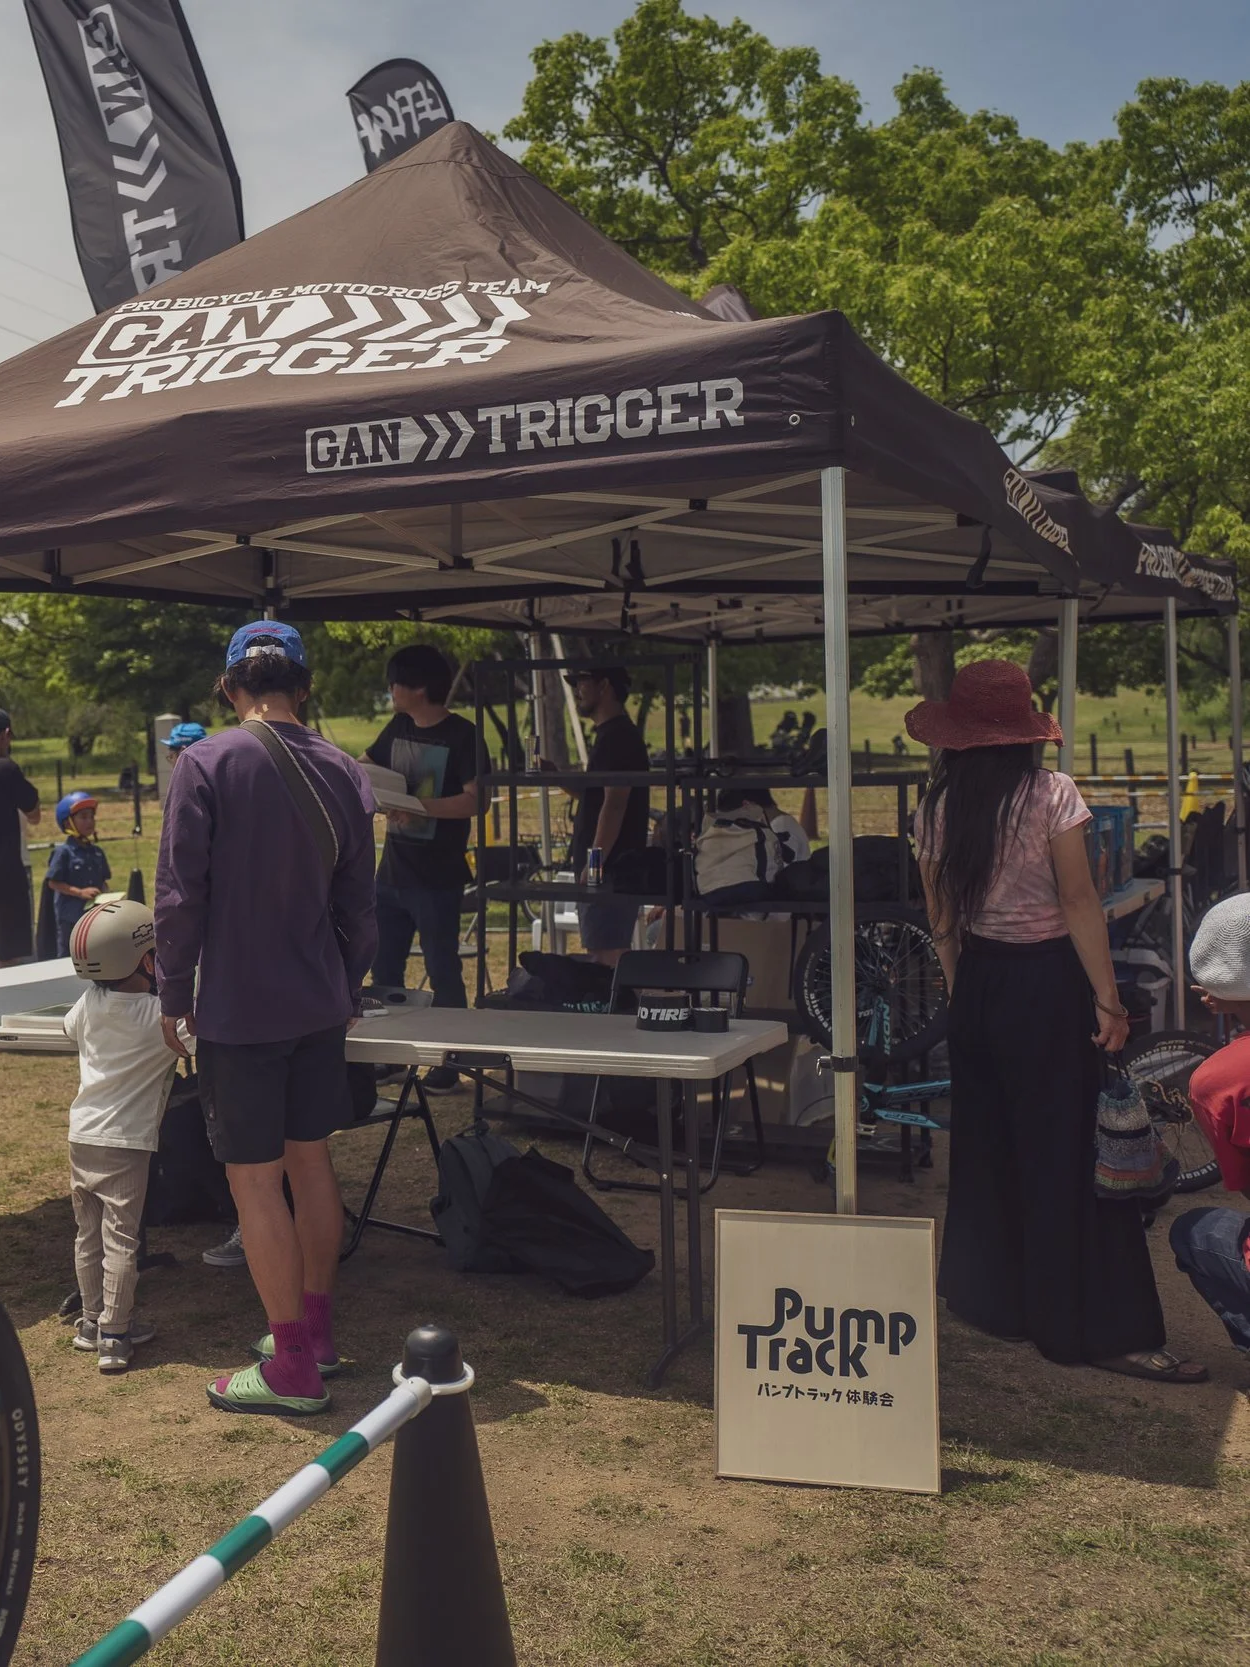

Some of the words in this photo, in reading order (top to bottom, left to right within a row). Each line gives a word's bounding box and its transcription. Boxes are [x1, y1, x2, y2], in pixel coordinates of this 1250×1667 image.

[116, 297, 174, 313] PRO
[174, 286, 288, 310] BICYCLE
[286, 280, 459, 300] MOTOCROSS
[467, 279, 552, 297] TEAM
[91, 300, 296, 360] GAN
[53, 338, 512, 408] TRIGGER
[310, 421, 403, 470] GAN
[477, 377, 746, 454] TRIGGER
[737, 1324, 869, 1379] Track
[774, 1287, 918, 1356] Pump
[757, 1382, 843, 1404] パンプトラック
[846, 1389, 895, 1408] 体験会
[11, 1407, 30, 1489] ODYSSEY
